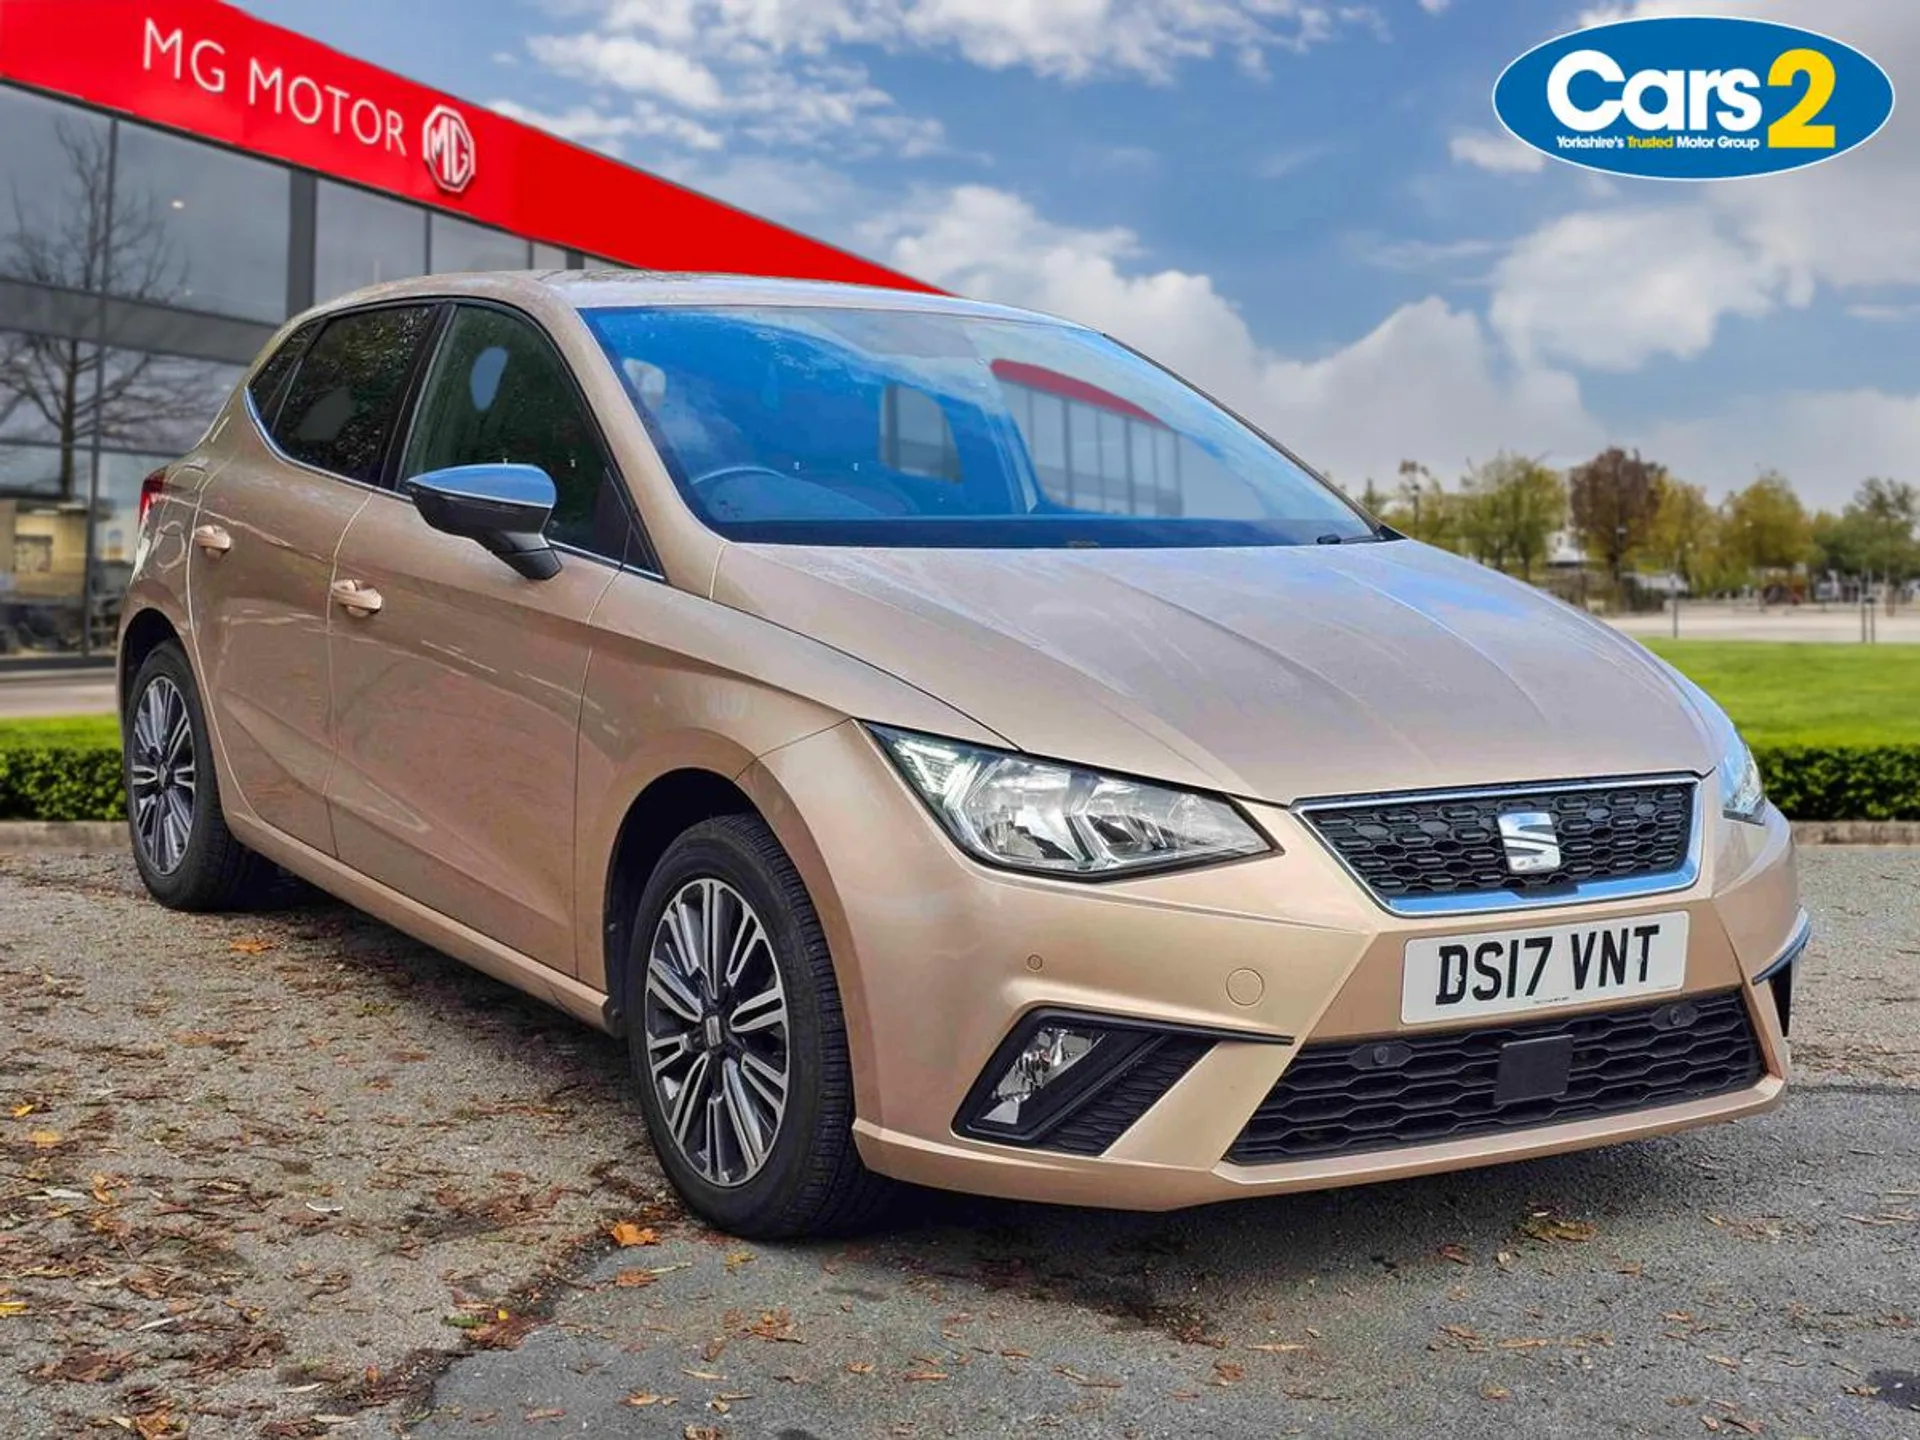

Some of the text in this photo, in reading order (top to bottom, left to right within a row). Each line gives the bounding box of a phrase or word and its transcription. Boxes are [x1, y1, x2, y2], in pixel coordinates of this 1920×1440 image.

[143, 17, 407, 157] MG MOTOR
[426, 108, 473, 189] MG
[1435, 924, 1660, 1005] DS17 VNT
